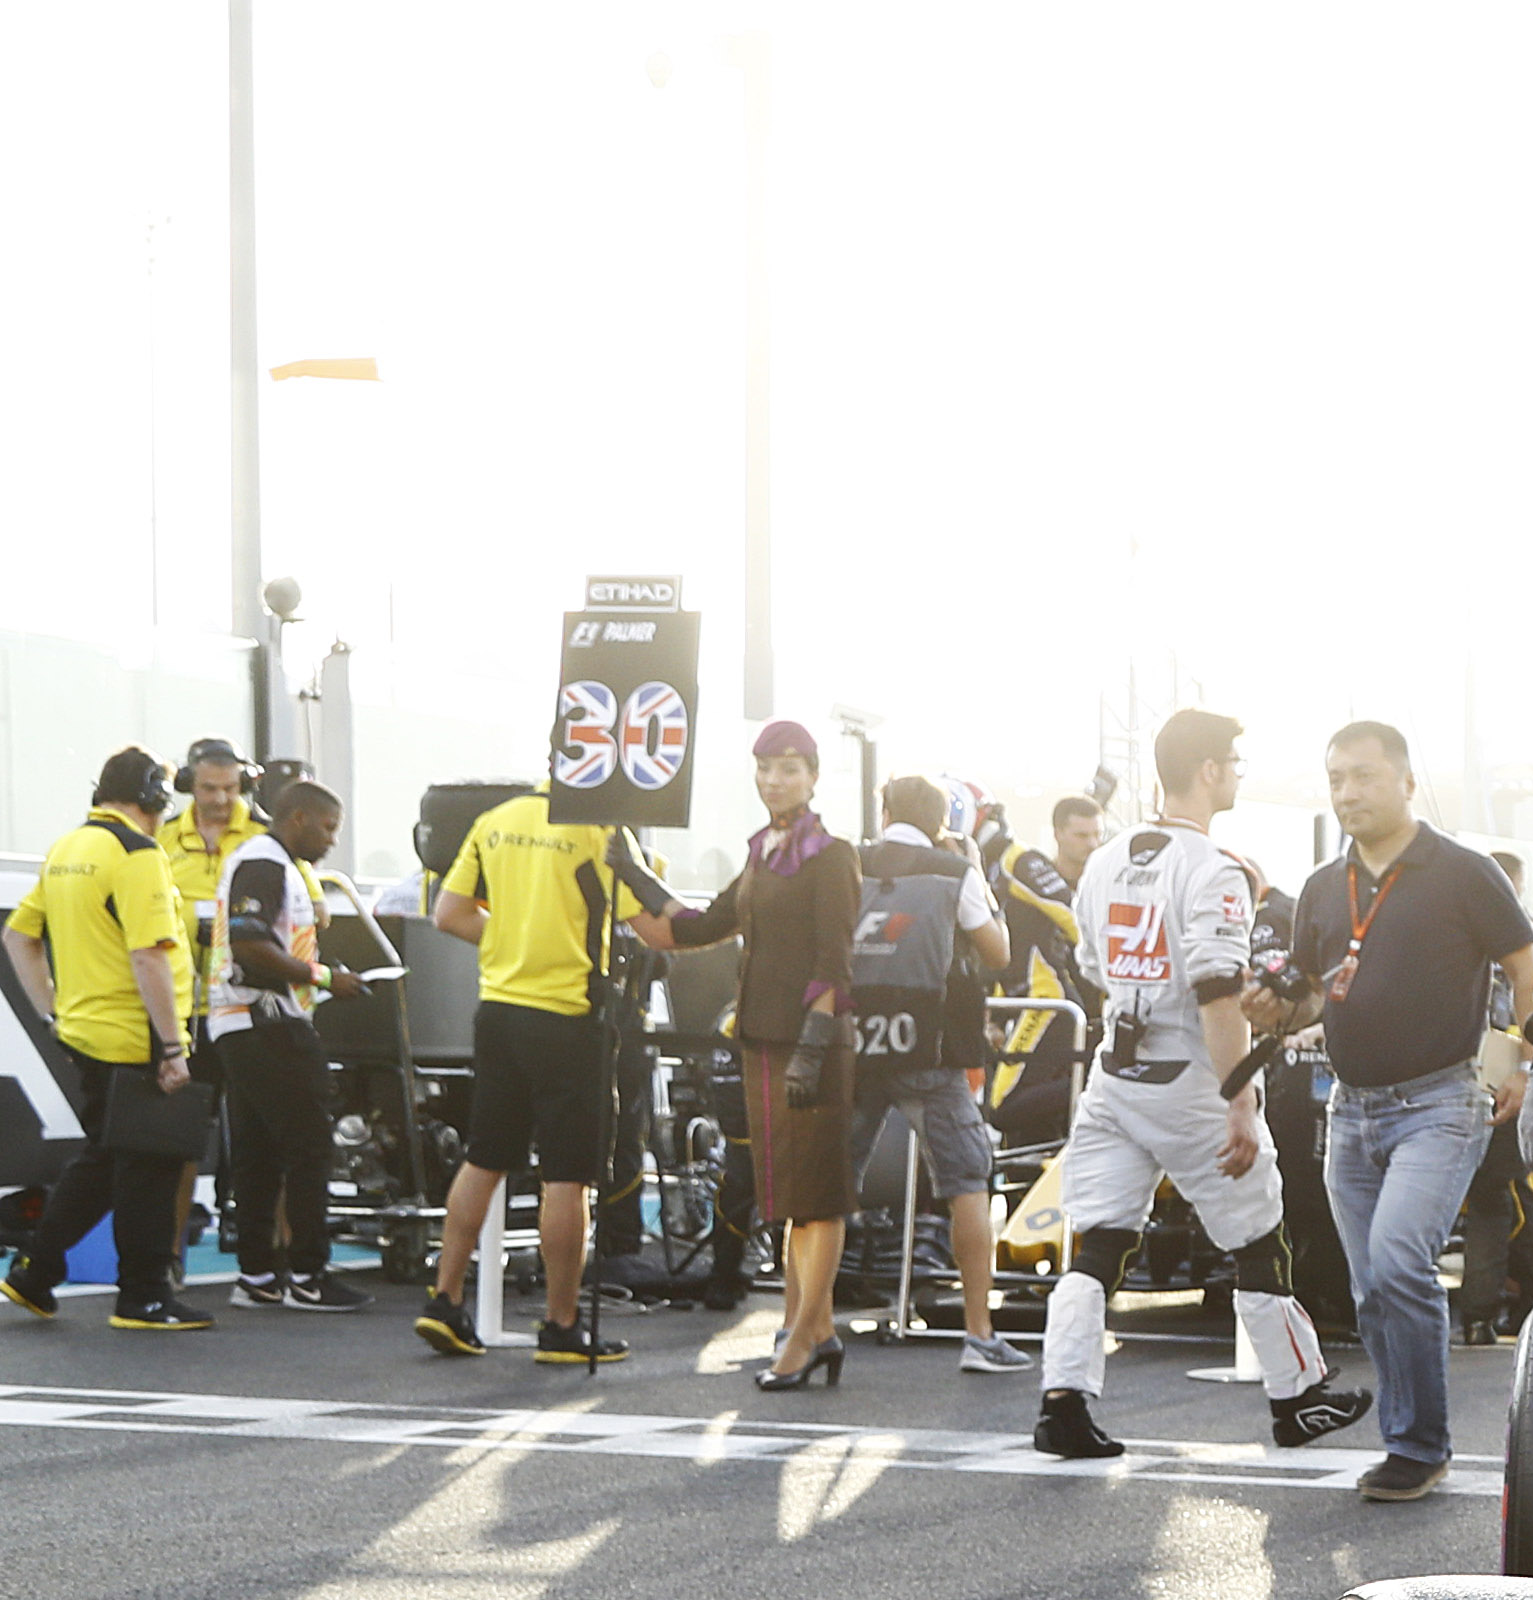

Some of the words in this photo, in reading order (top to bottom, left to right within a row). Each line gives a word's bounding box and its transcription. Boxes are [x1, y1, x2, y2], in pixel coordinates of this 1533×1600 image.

[589, 582, 674, 601] ETIHAD
[603, 621, 656, 642] PALMER
[554, 680, 689, 790] 30
[1107, 954, 1168, 979] HAAS
